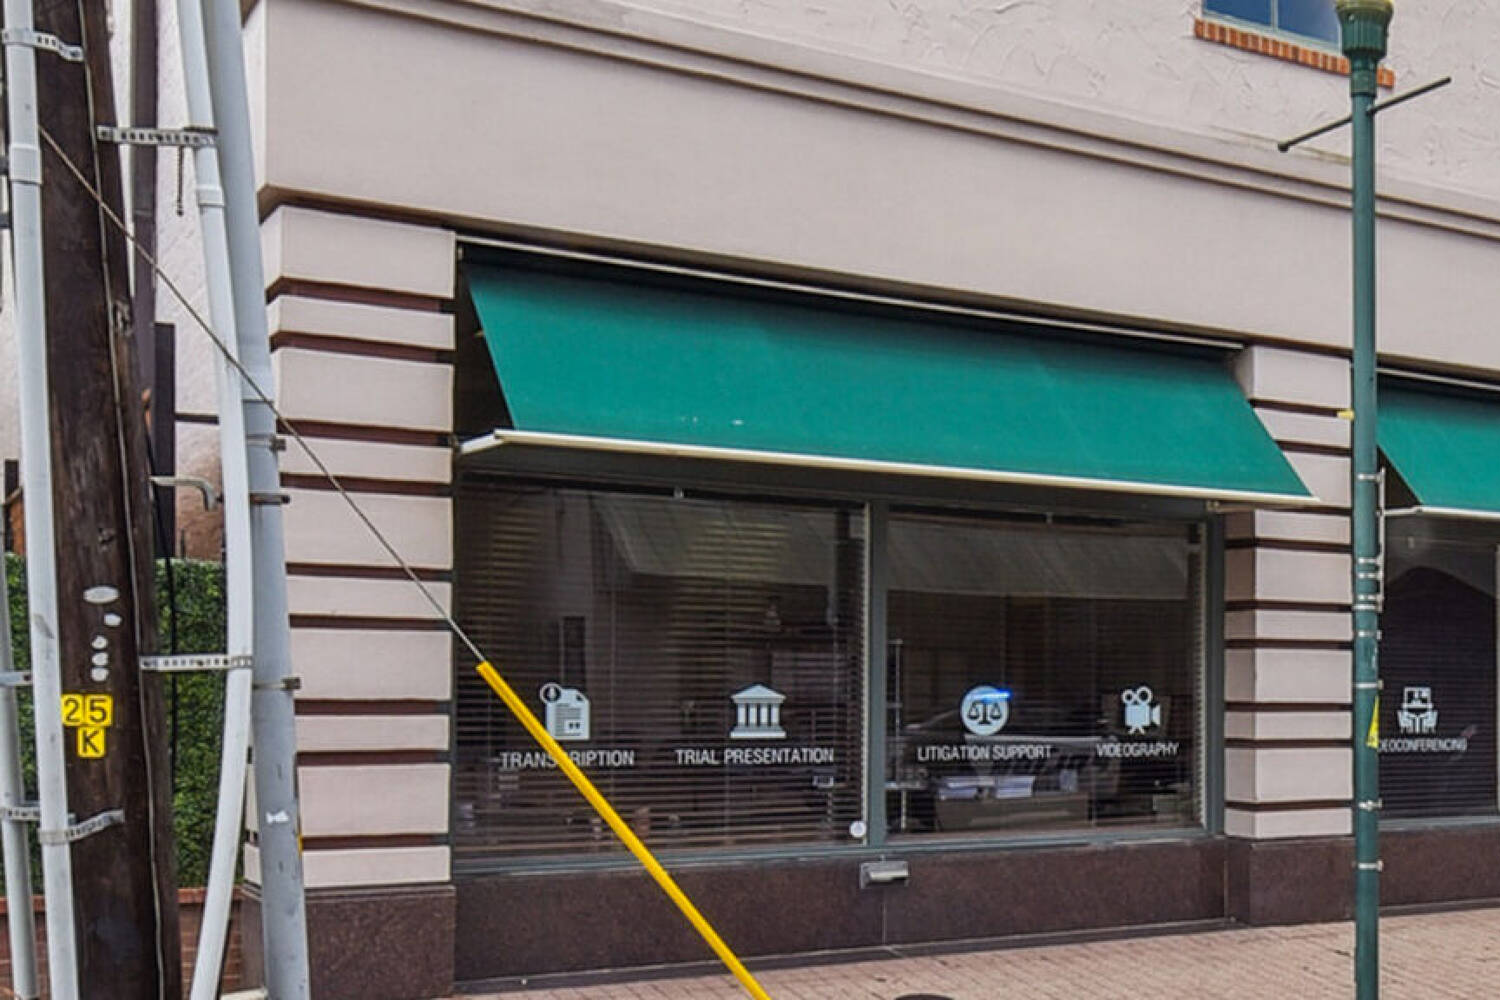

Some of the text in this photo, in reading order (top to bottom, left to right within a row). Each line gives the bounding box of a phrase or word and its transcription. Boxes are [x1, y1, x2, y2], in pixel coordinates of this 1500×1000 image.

[64, 697, 107, 723] 25
[82, 730, 100, 753] K
[1096, 741, 1180, 758] VIDEOGRAPHY
[500, 750, 635, 768] TRANSRIPTION
[676, 747, 834, 765] TRIAL PRESENTATION
[918, 743, 1051, 761] LITIGATION SUPPORT
